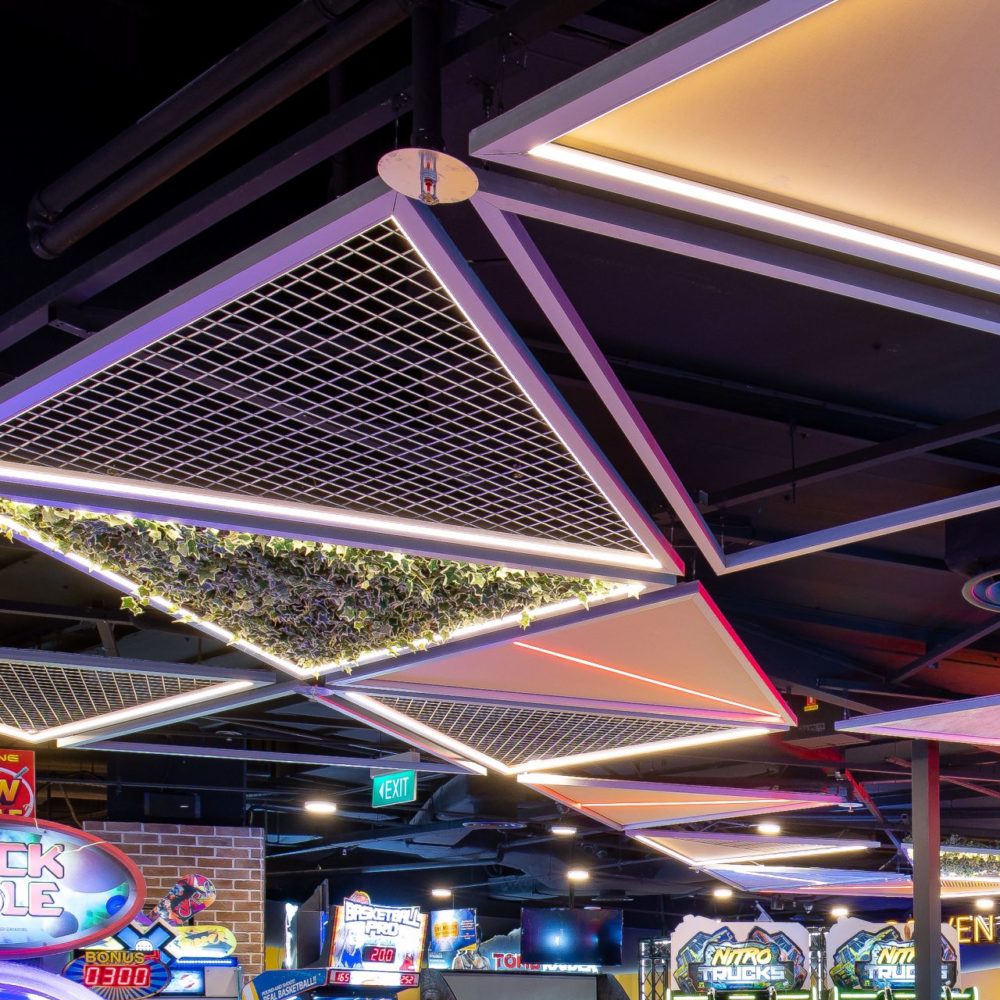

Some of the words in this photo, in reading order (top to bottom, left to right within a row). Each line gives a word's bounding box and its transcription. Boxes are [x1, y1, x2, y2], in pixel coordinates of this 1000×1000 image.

[385, 776, 409, 800] EXIT
[345, 900, 421, 928] BASKETBALL
[365, 920, 399, 937] PRO
[85, 951, 145, 964] BONUS
[370, 948, 394, 961] 200
[711, 947, 772, 966] NITRO
[877, 947, 915, 965] NIT
[85, 966, 149, 986] 0300
[698, 966, 785, 982] TRUCKS
